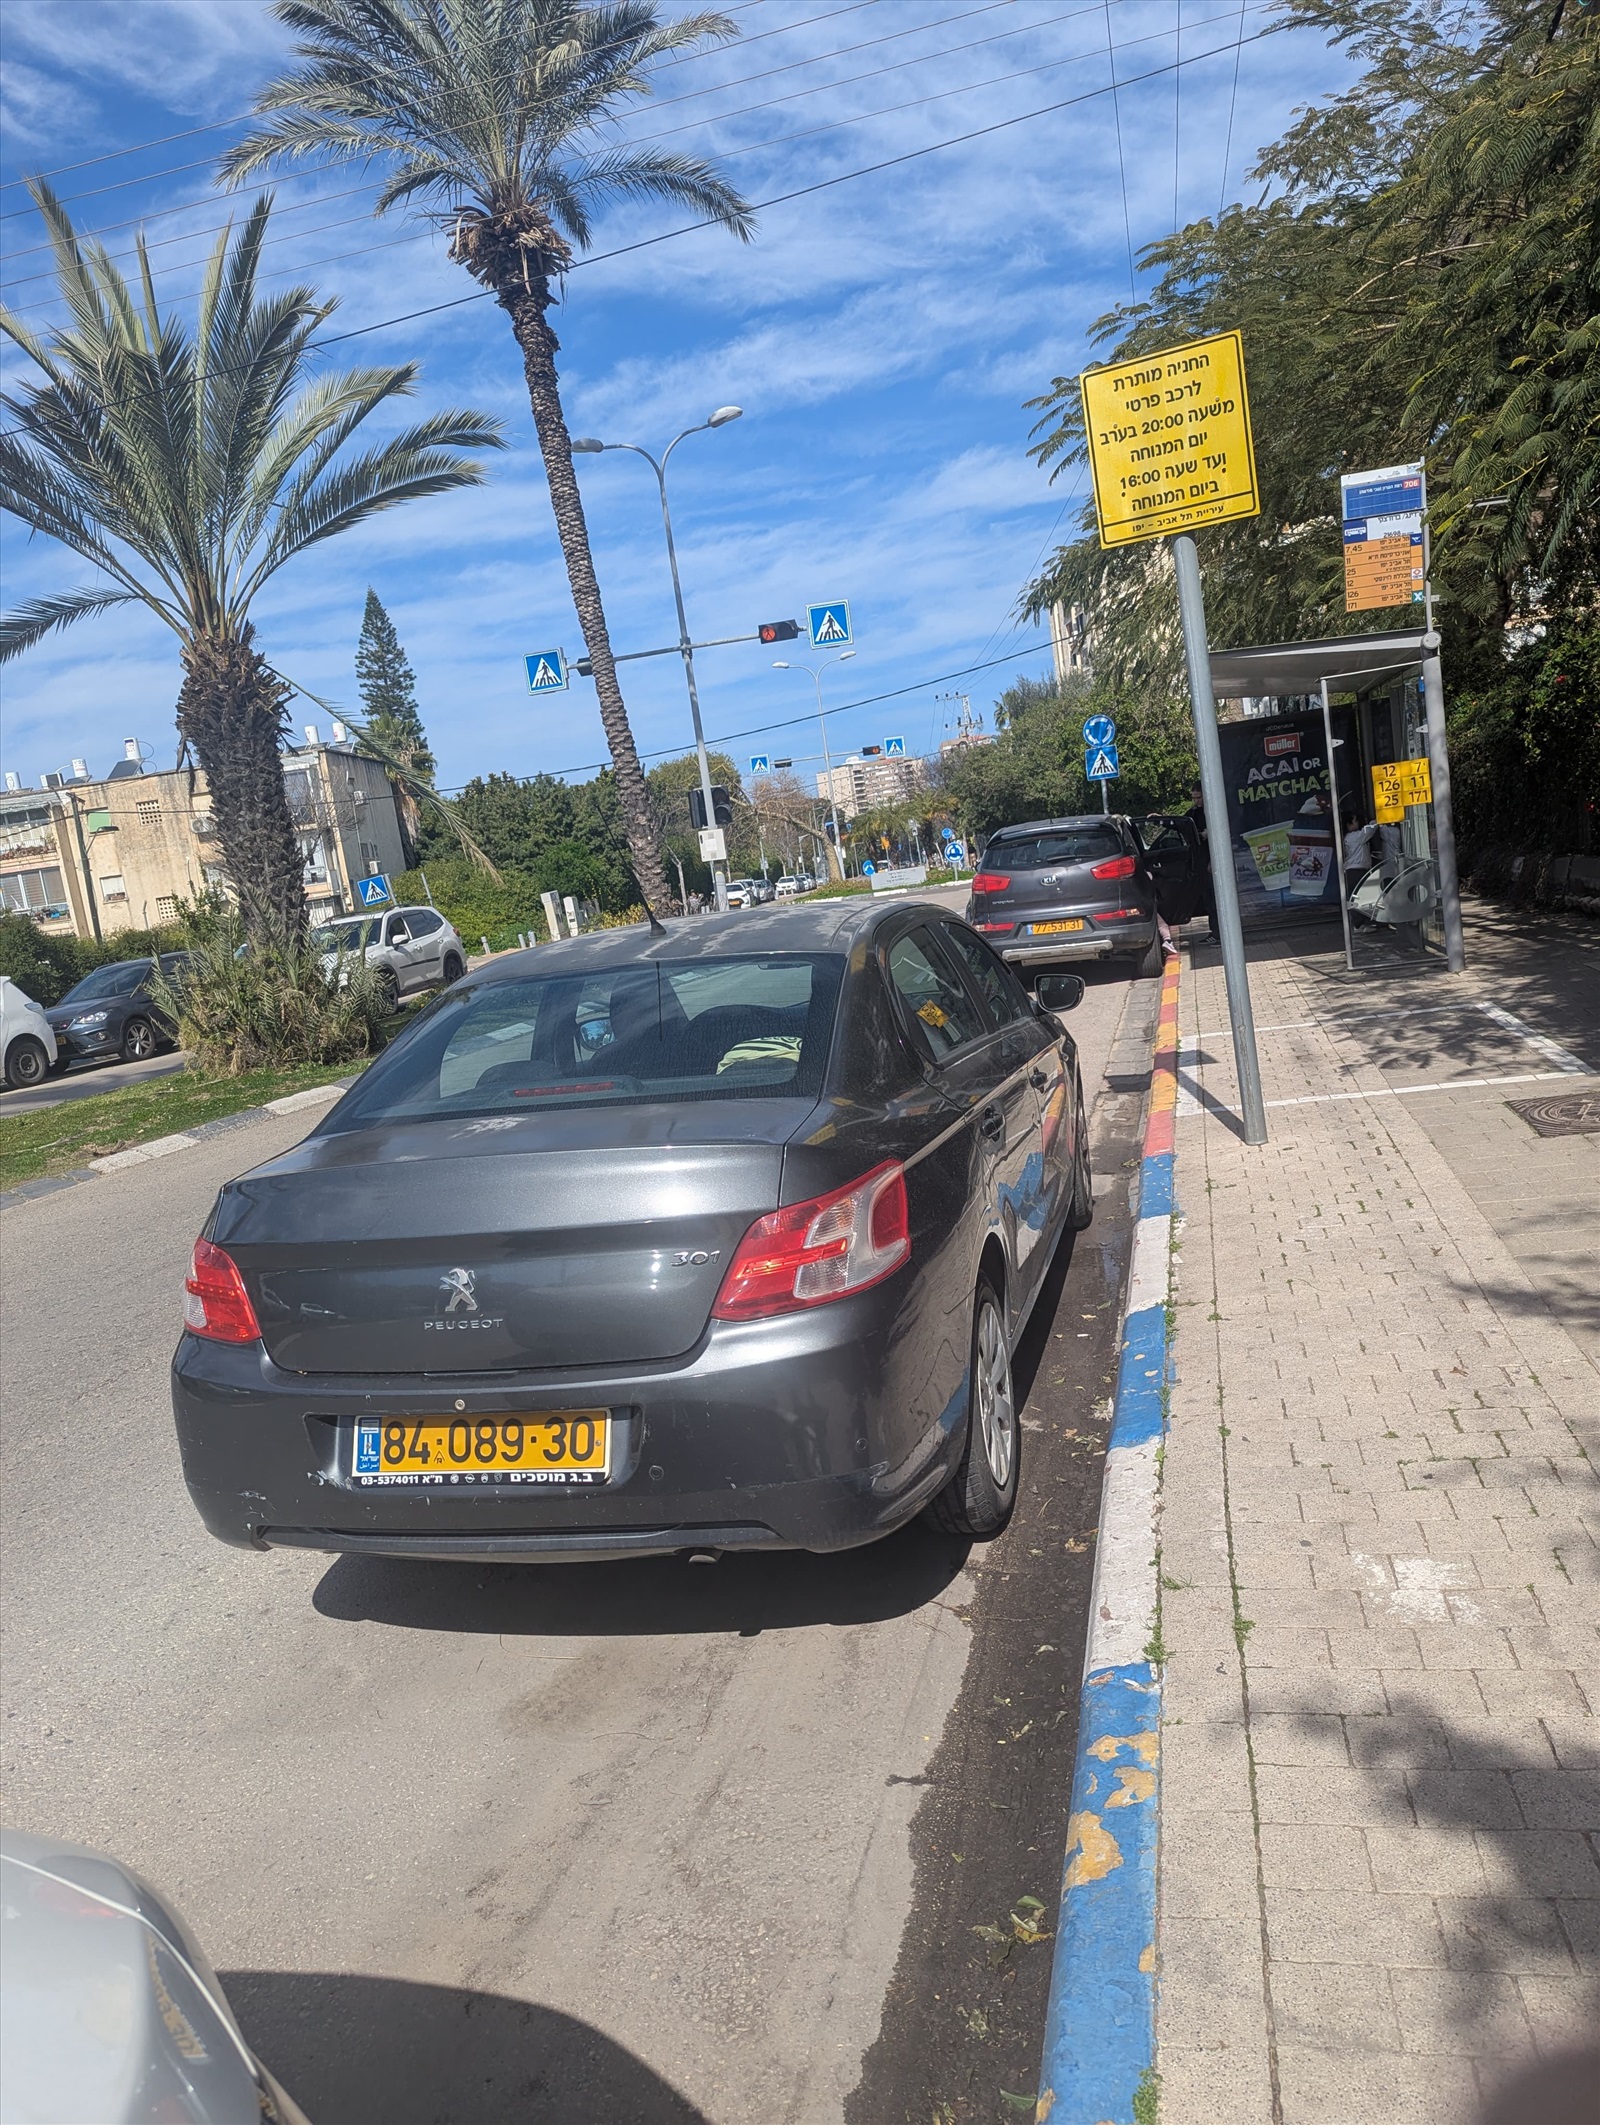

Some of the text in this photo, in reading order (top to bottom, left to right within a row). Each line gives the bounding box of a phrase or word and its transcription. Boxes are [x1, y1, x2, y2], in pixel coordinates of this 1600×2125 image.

[1113, 355, 1210, 392] החניה מותרת
[1126, 380, 1202, 412] לרכב פרטי
[1100, 399, 1235, 446] משעה 20:00 בערב
[1130, 432, 1207, 463] יום המנוחה
[1120, 453, 1227, 489] ועד שעה 16:00
[1132, 480, 1219, 512] ביום המנוחה
[1180, 512, 1193, 522] תל
[1196, 504, 1225, 517] עיריית
[1133, 523, 1145, 533] יפו
[1157, 516, 1177, 527] אביב
[1347, 568, 1356, 576] 25
[1347, 590, 1359, 598] 126
[1269, 738, 1296, 751] müller
[1247, 757, 1321, 784] ACAI OR
[1382, 765, 1396, 777] 12
[1378, 779, 1400, 792] 126
[1410, 775, 1425, 788] 11
[1384, 794, 1399, 807] 25
[1409, 790, 1428, 802] 171
[1043, 874, 1057, 884] KIA
[670, 1250, 720, 1267] 301
[424, 1319, 503, 1330] PEUGEOT
[363, 1433, 377, 1454] IL
[361, 1473, 593, 1485] ב.ג מוסכים ת"א 03-5374011
